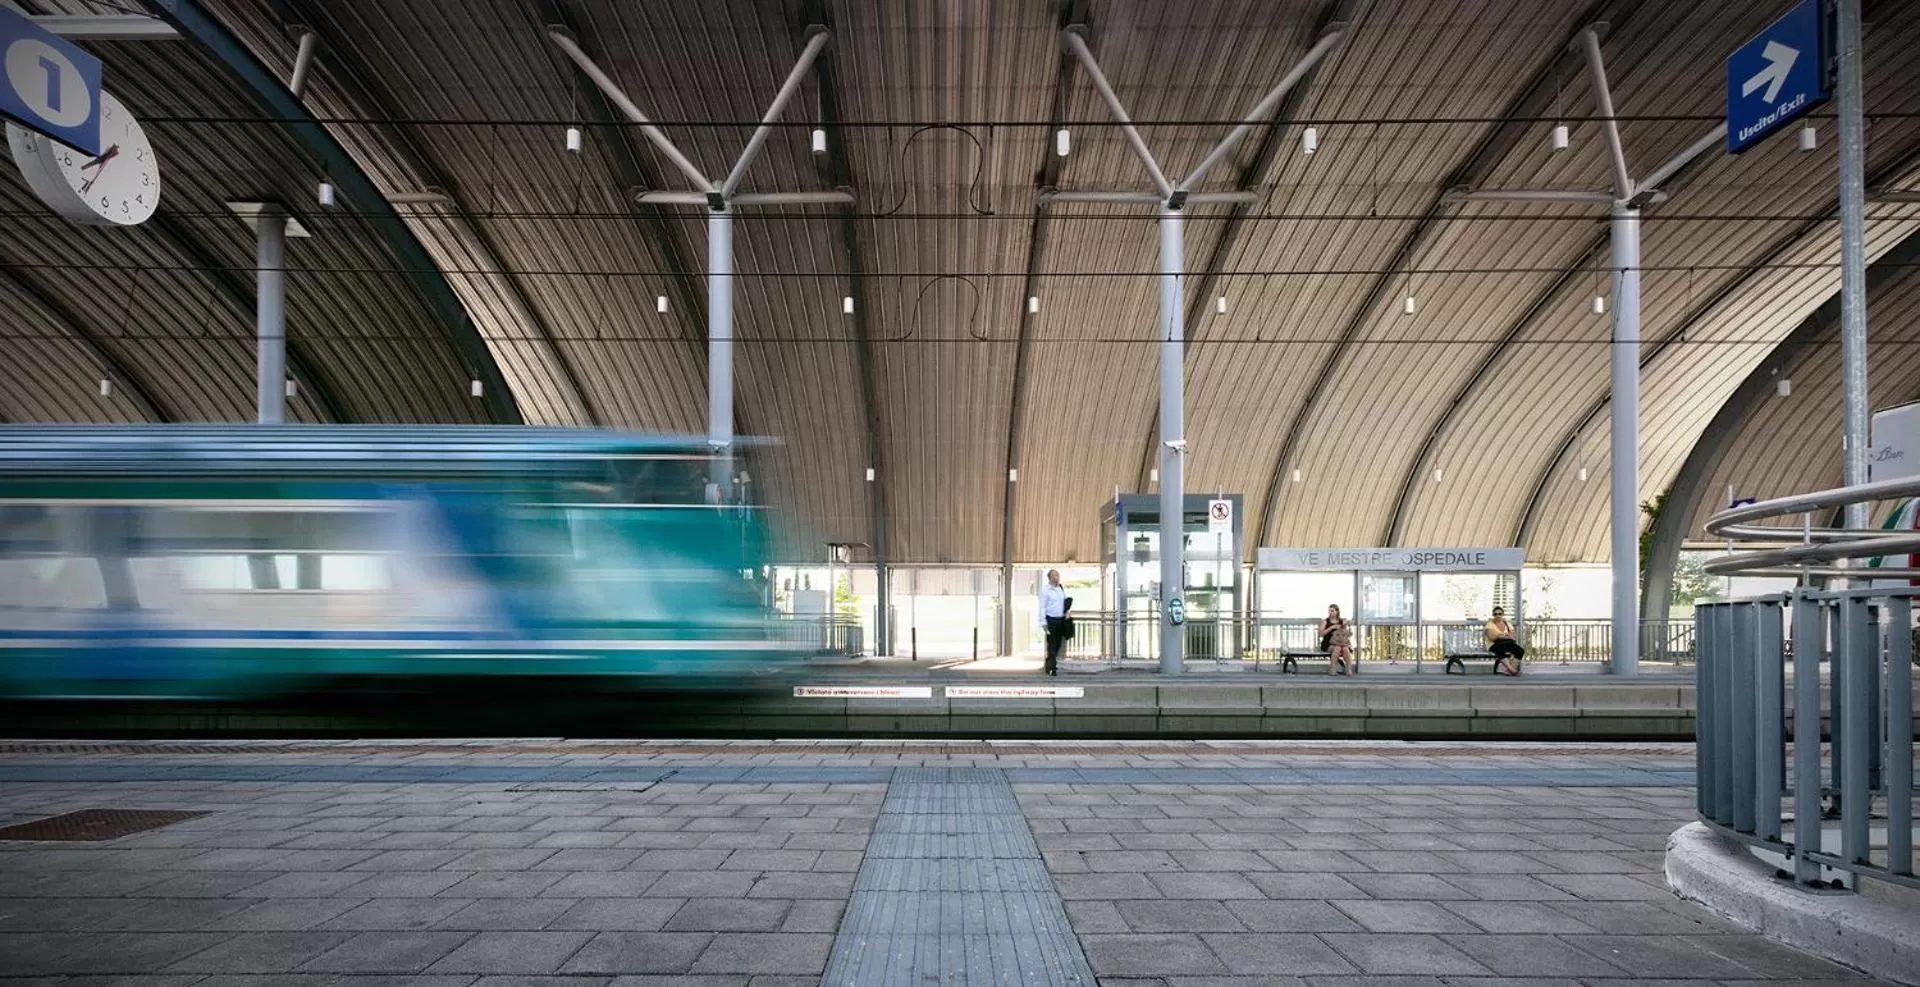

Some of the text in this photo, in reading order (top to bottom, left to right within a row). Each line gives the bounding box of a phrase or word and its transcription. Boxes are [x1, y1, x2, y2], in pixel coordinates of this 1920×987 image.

[39, 55, 62, 113] 1
[1738, 93, 1806, 142] Uscita/Exit
[101, 195, 110, 209] 6
[1299, 552, 1486, 566] VE MESTRE OSPEDALE
